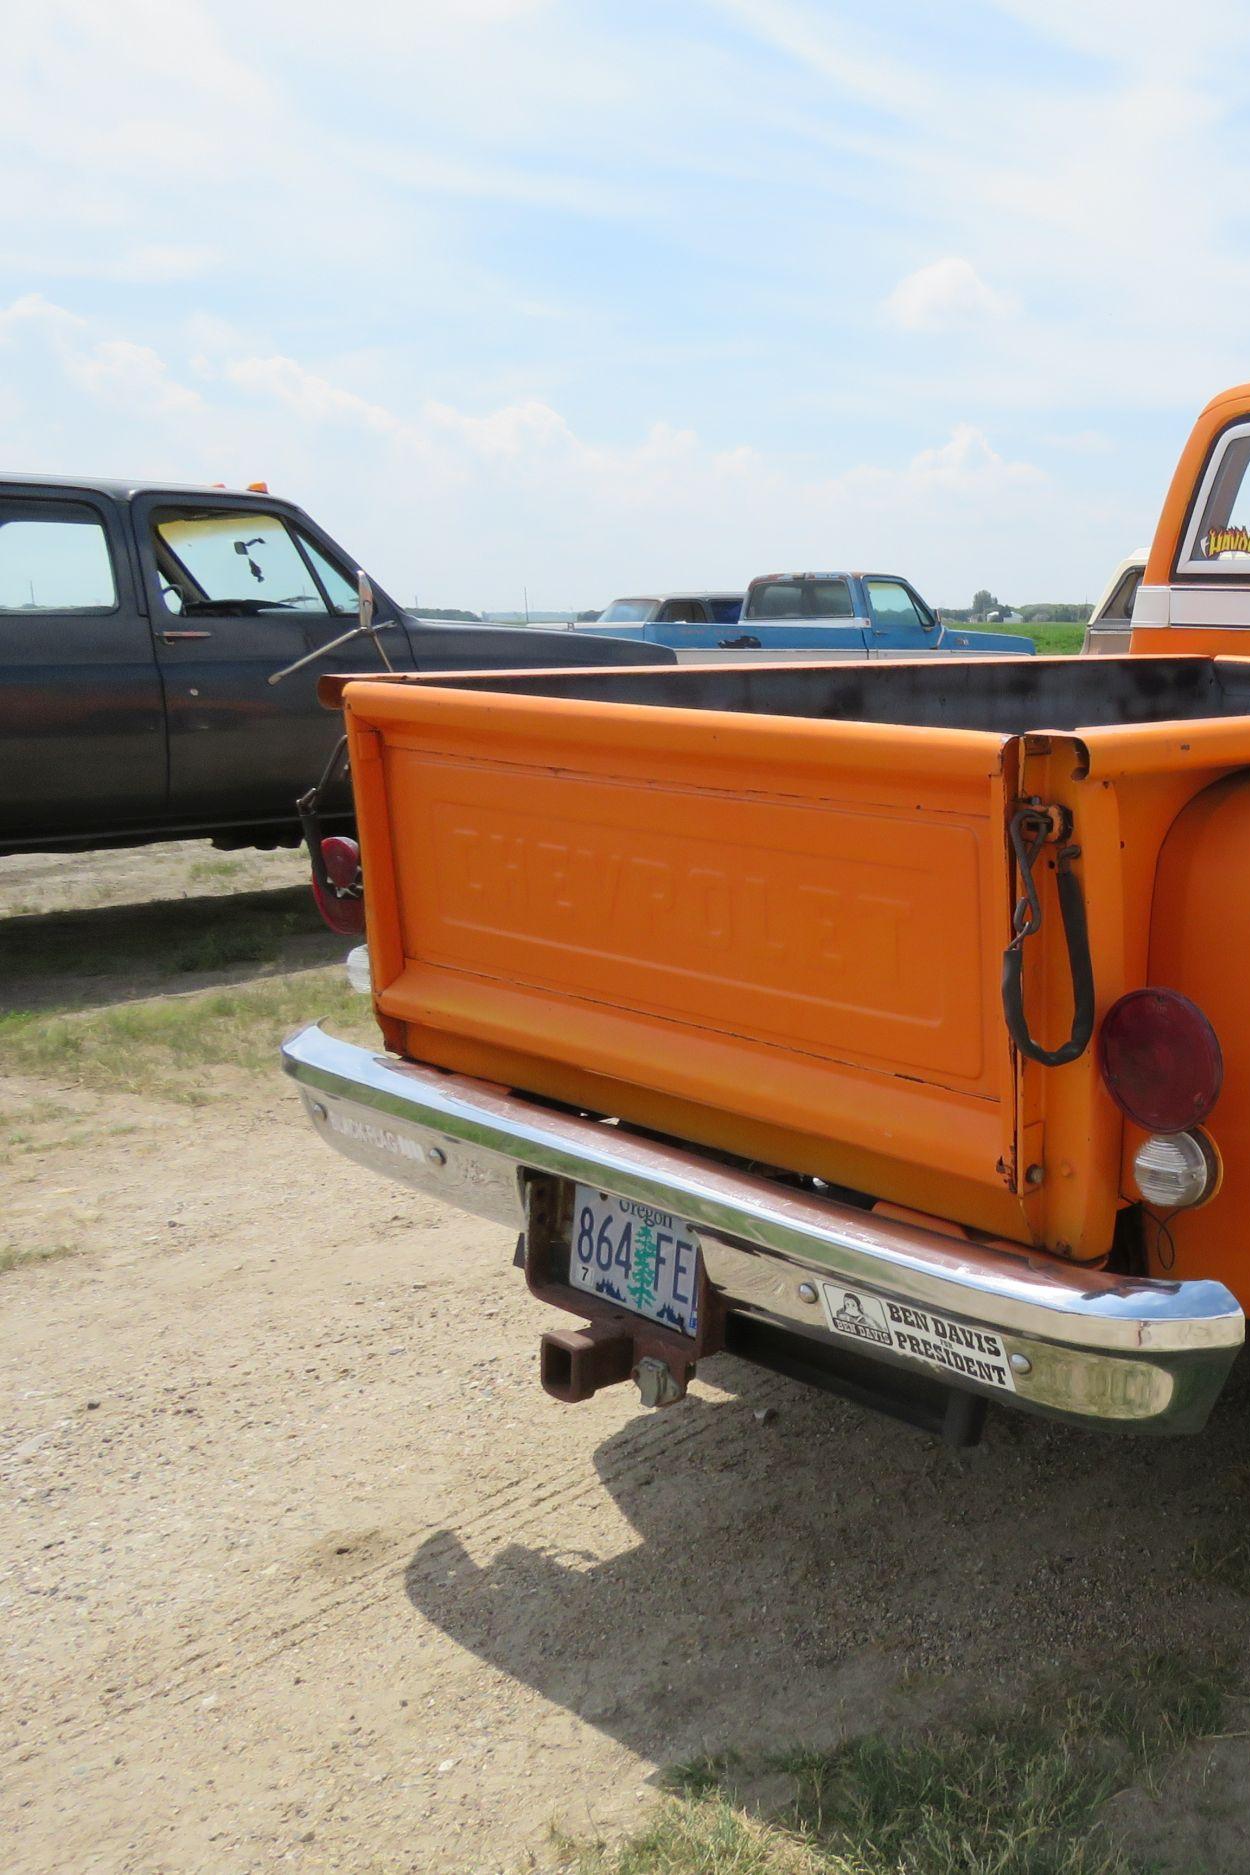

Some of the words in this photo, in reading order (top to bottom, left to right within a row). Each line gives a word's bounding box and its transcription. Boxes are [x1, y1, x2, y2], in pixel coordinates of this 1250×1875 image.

[619, 1199, 673, 1230] Oregon
[577, 1206, 632, 1280] 864
[581, 1266, 589, 1281] 7
[837, 1320, 857, 1335] BEN
[858, 1325, 890, 1344] DAVIS
[888, 1303, 931, 1333] BEN
[931, 1317, 1002, 1357] DAVIS
[895, 1331, 1006, 1385] PRESIDENT
